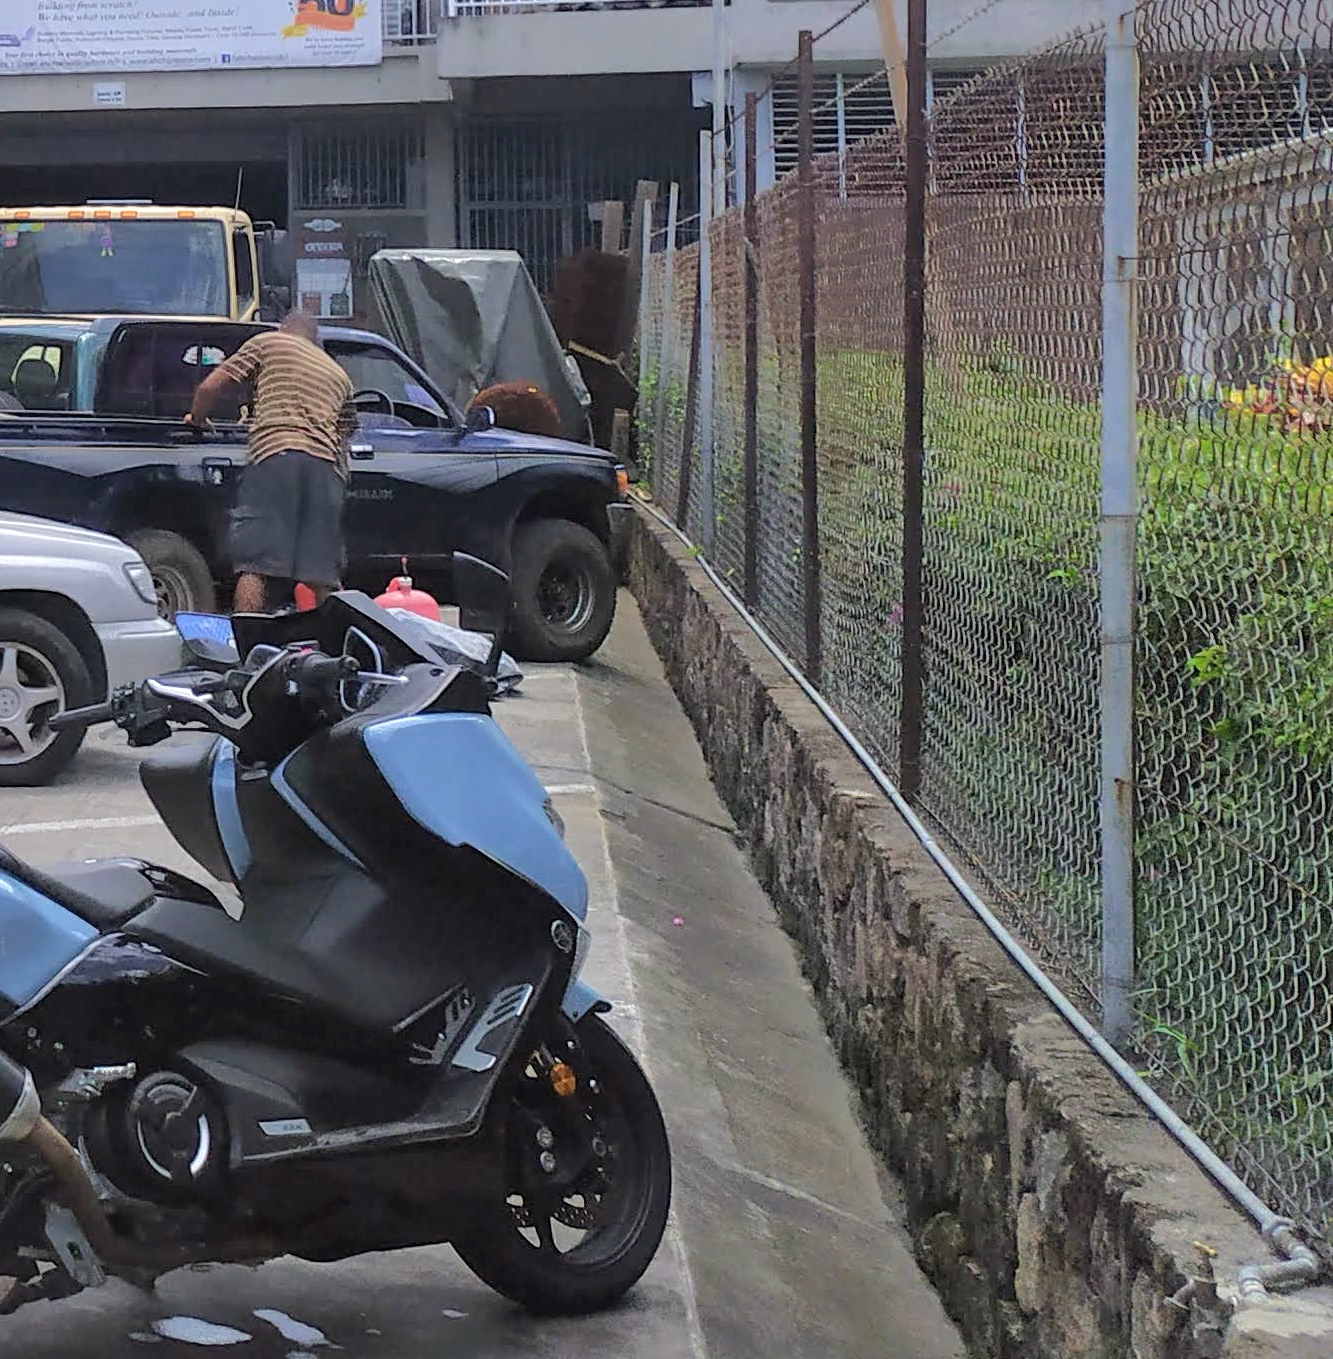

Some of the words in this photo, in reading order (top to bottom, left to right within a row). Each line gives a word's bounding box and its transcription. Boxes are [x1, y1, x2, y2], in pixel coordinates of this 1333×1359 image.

[77, 1, 98, 10] from
[38, 13, 52, 21] We
[53, 13, 74, 21] have
[76, 12, 98, 20] what
[100, 13, 117, 22] you
[187, 9, 206, 17] and
